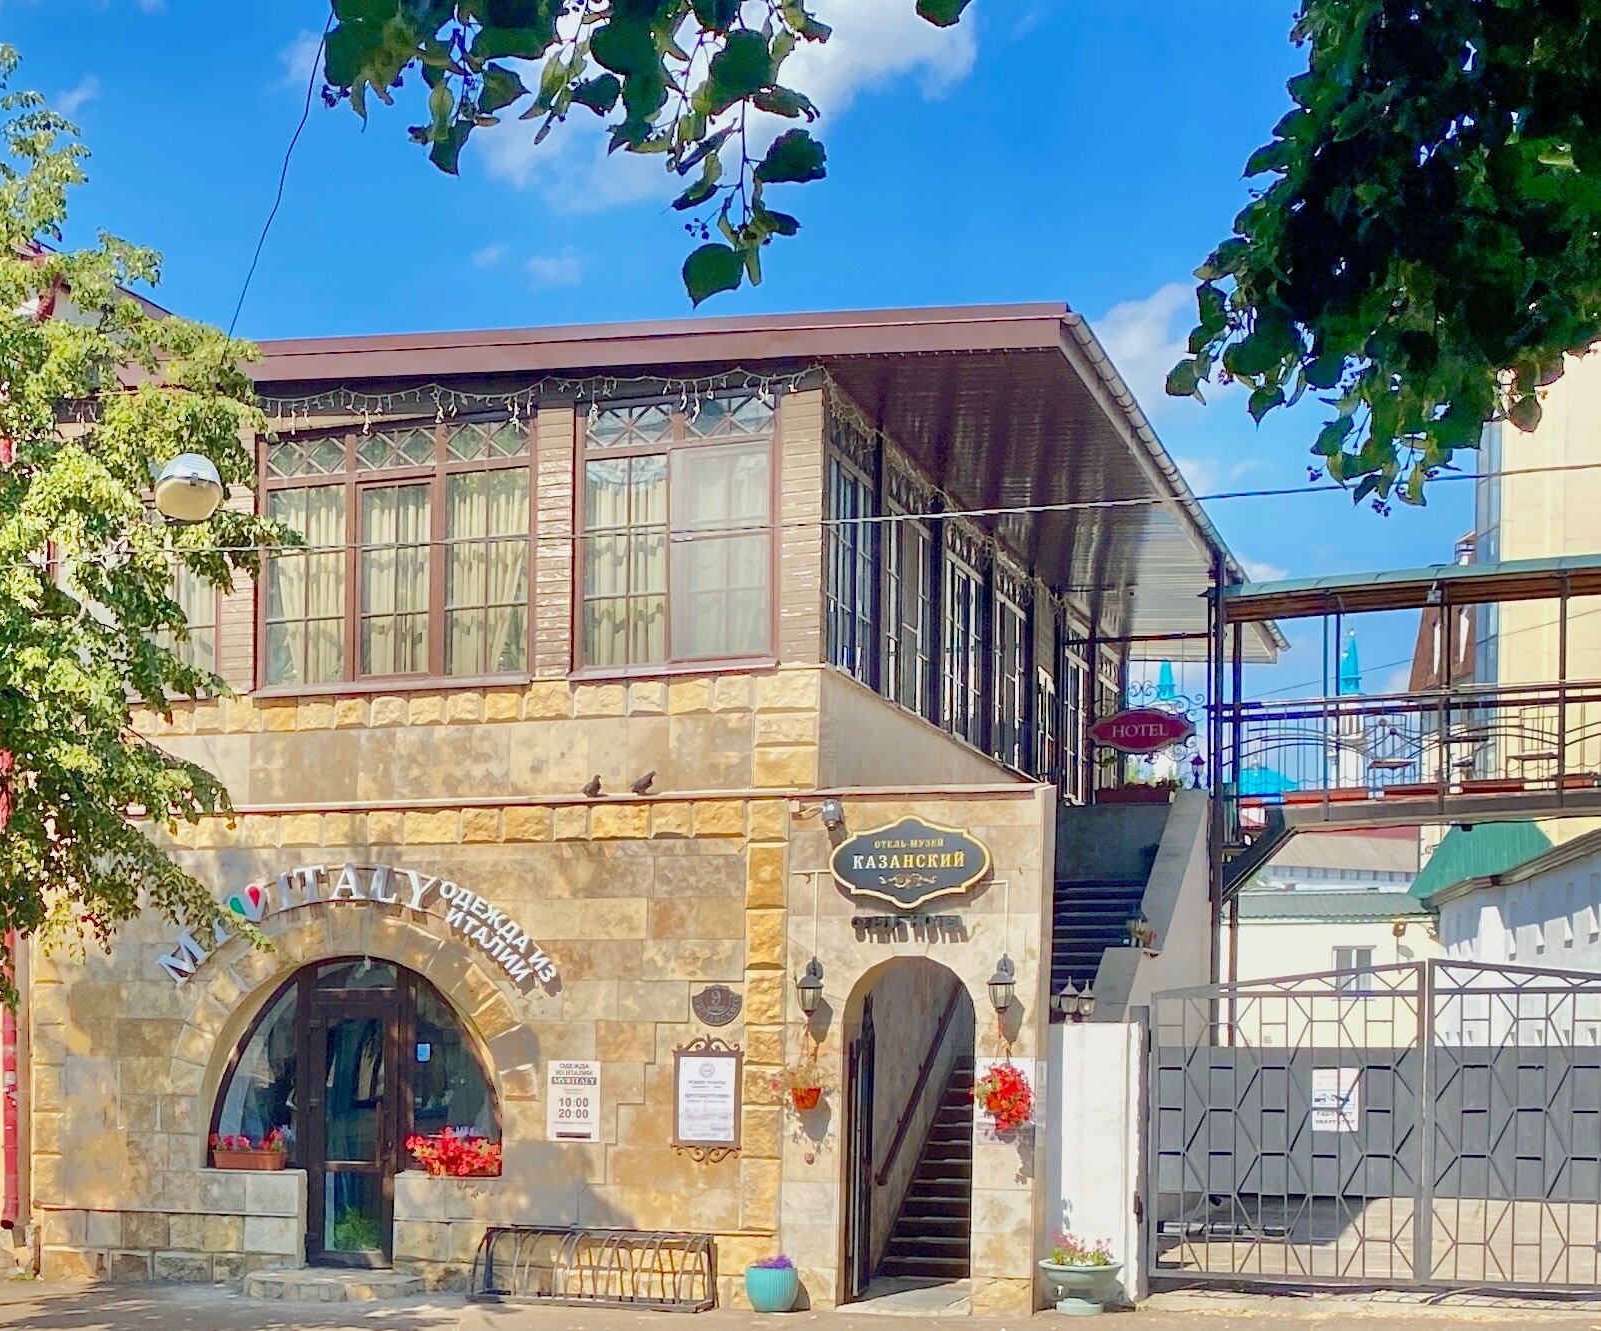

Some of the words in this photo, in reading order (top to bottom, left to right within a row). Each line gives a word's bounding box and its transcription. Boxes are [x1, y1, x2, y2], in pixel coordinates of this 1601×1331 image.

[1111, 723, 1168, 738] HOTEL
[874, 838, 944, 849] ОТЕЛЬ-МУЗЕЙ
[852, 850, 965, 870] КАЗАНСКИЙ
[276, 863, 438, 912] ITALY
[439, 880, 530, 953] ОДЕЖДА
[527, 949, 557, 983] ИЗ
[445, 906, 533, 982] ИТАЛИИ
[711, 990, 721, 1006] 9
[559, 1097, 589, 1107] 10:00
